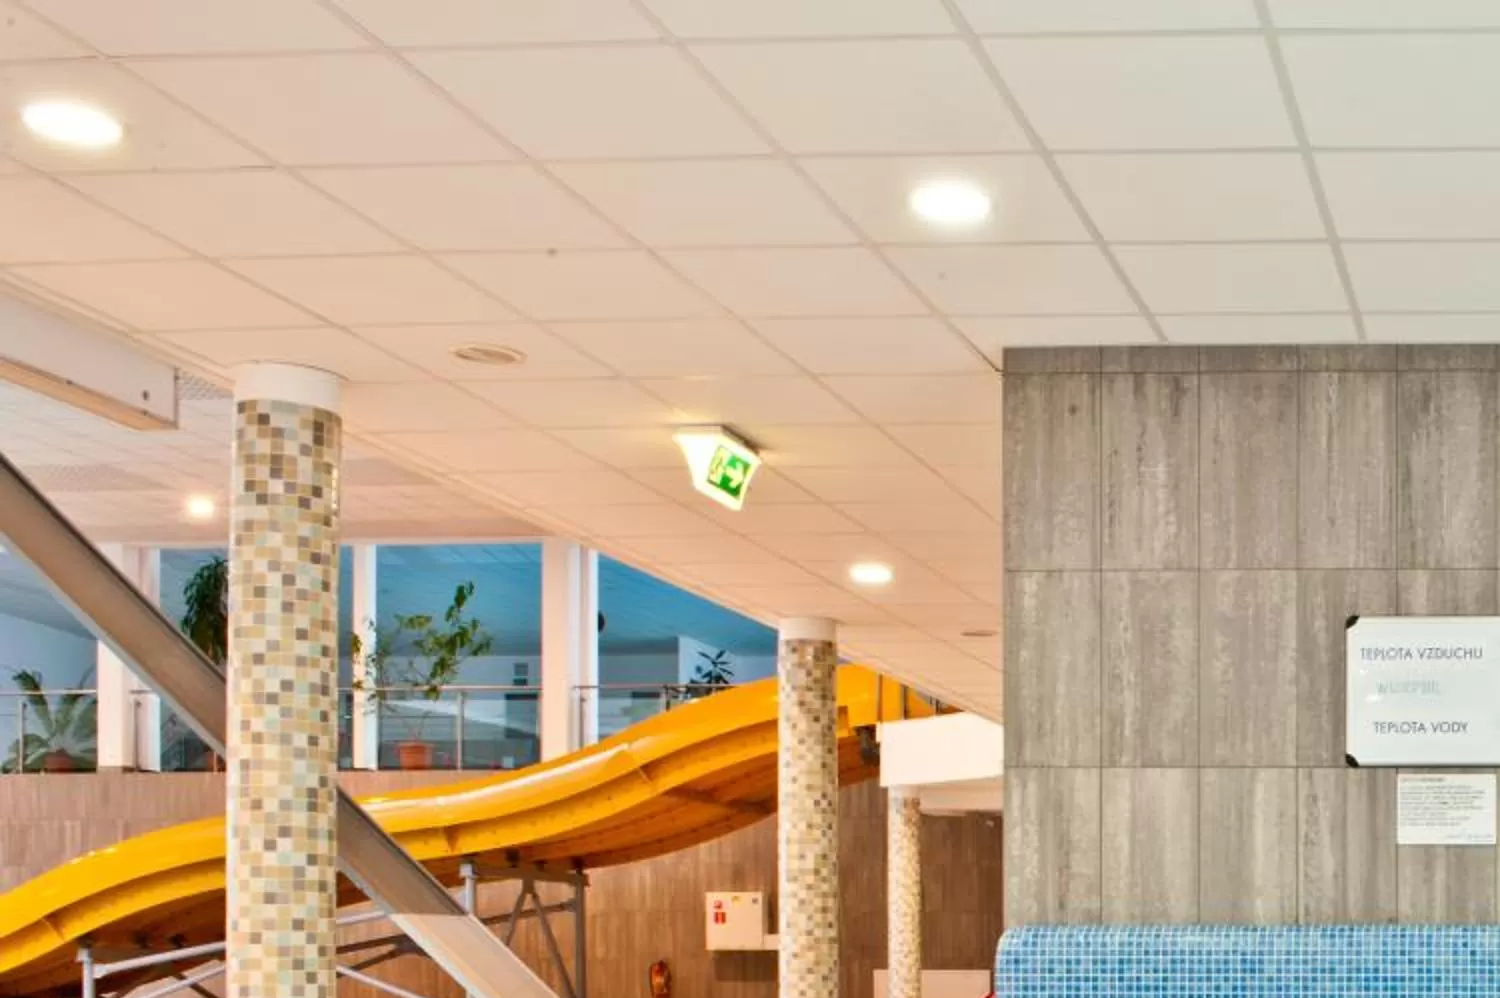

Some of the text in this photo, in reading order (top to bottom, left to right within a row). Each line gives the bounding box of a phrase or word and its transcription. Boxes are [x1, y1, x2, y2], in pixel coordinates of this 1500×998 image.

[1360, 647, 1413, 661] TEPLOTA
[1417, 647, 1484, 661] VZDUCHU
[1374, 721, 1469, 734] TEPLOTA VODY
